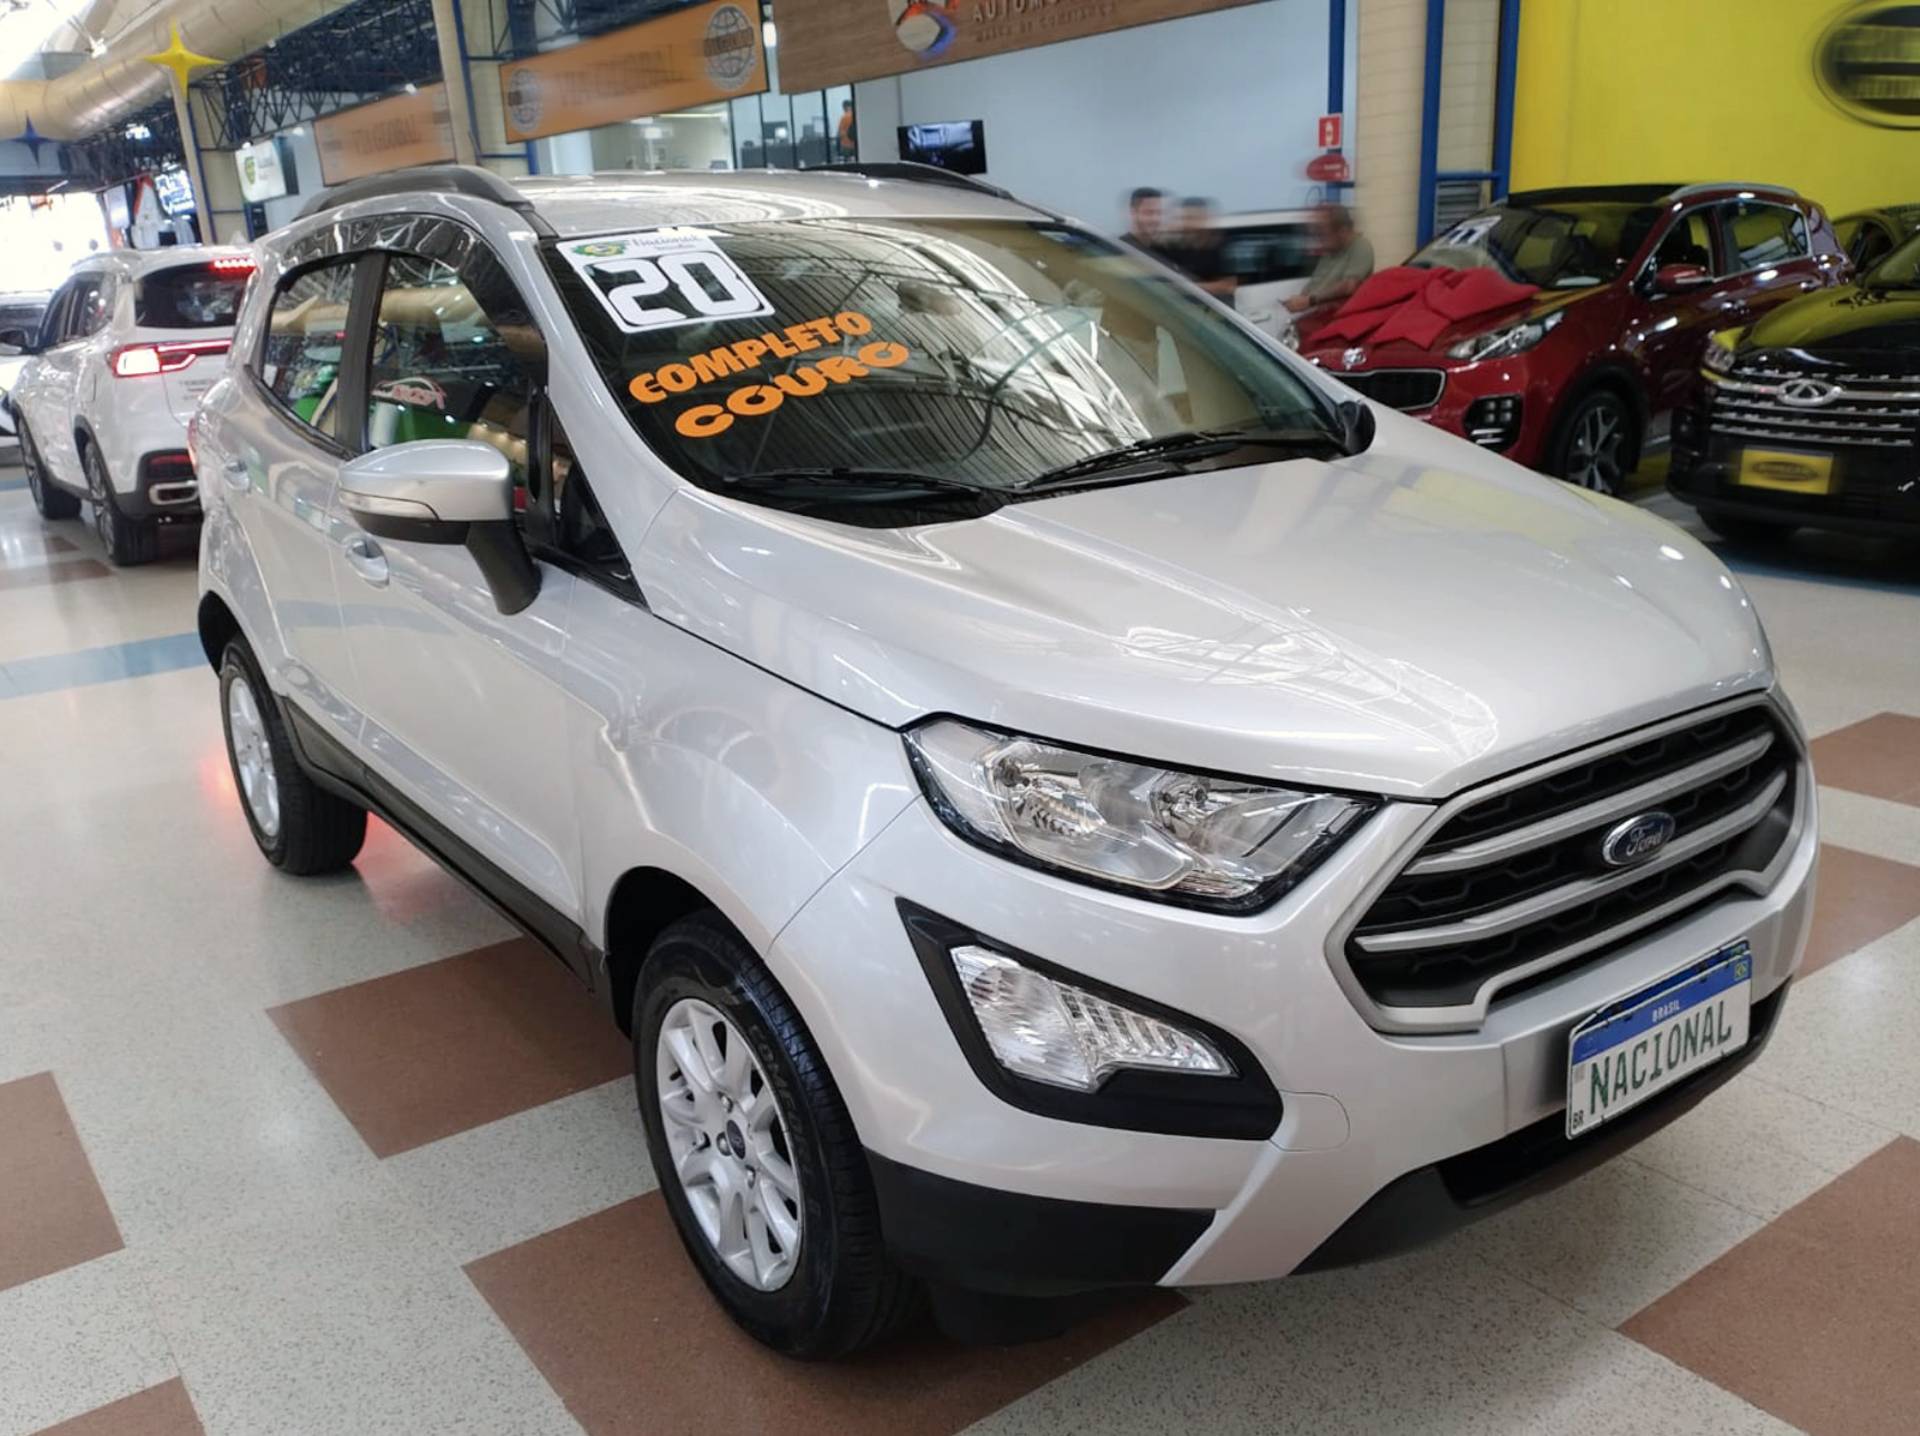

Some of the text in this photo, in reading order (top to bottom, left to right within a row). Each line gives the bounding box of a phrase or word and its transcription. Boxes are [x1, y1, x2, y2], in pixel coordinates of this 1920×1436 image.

[593, 251, 761, 326] 20
[629, 311, 872, 403] COMPLETO
[675, 341, 909, 438] COURO
[1625, 821, 1664, 857] Ford
[1652, 1000, 1680, 1023] BRASIL
[1590, 1000, 1732, 1115] NACIONAL
[1572, 1109, 1584, 1130] BR
